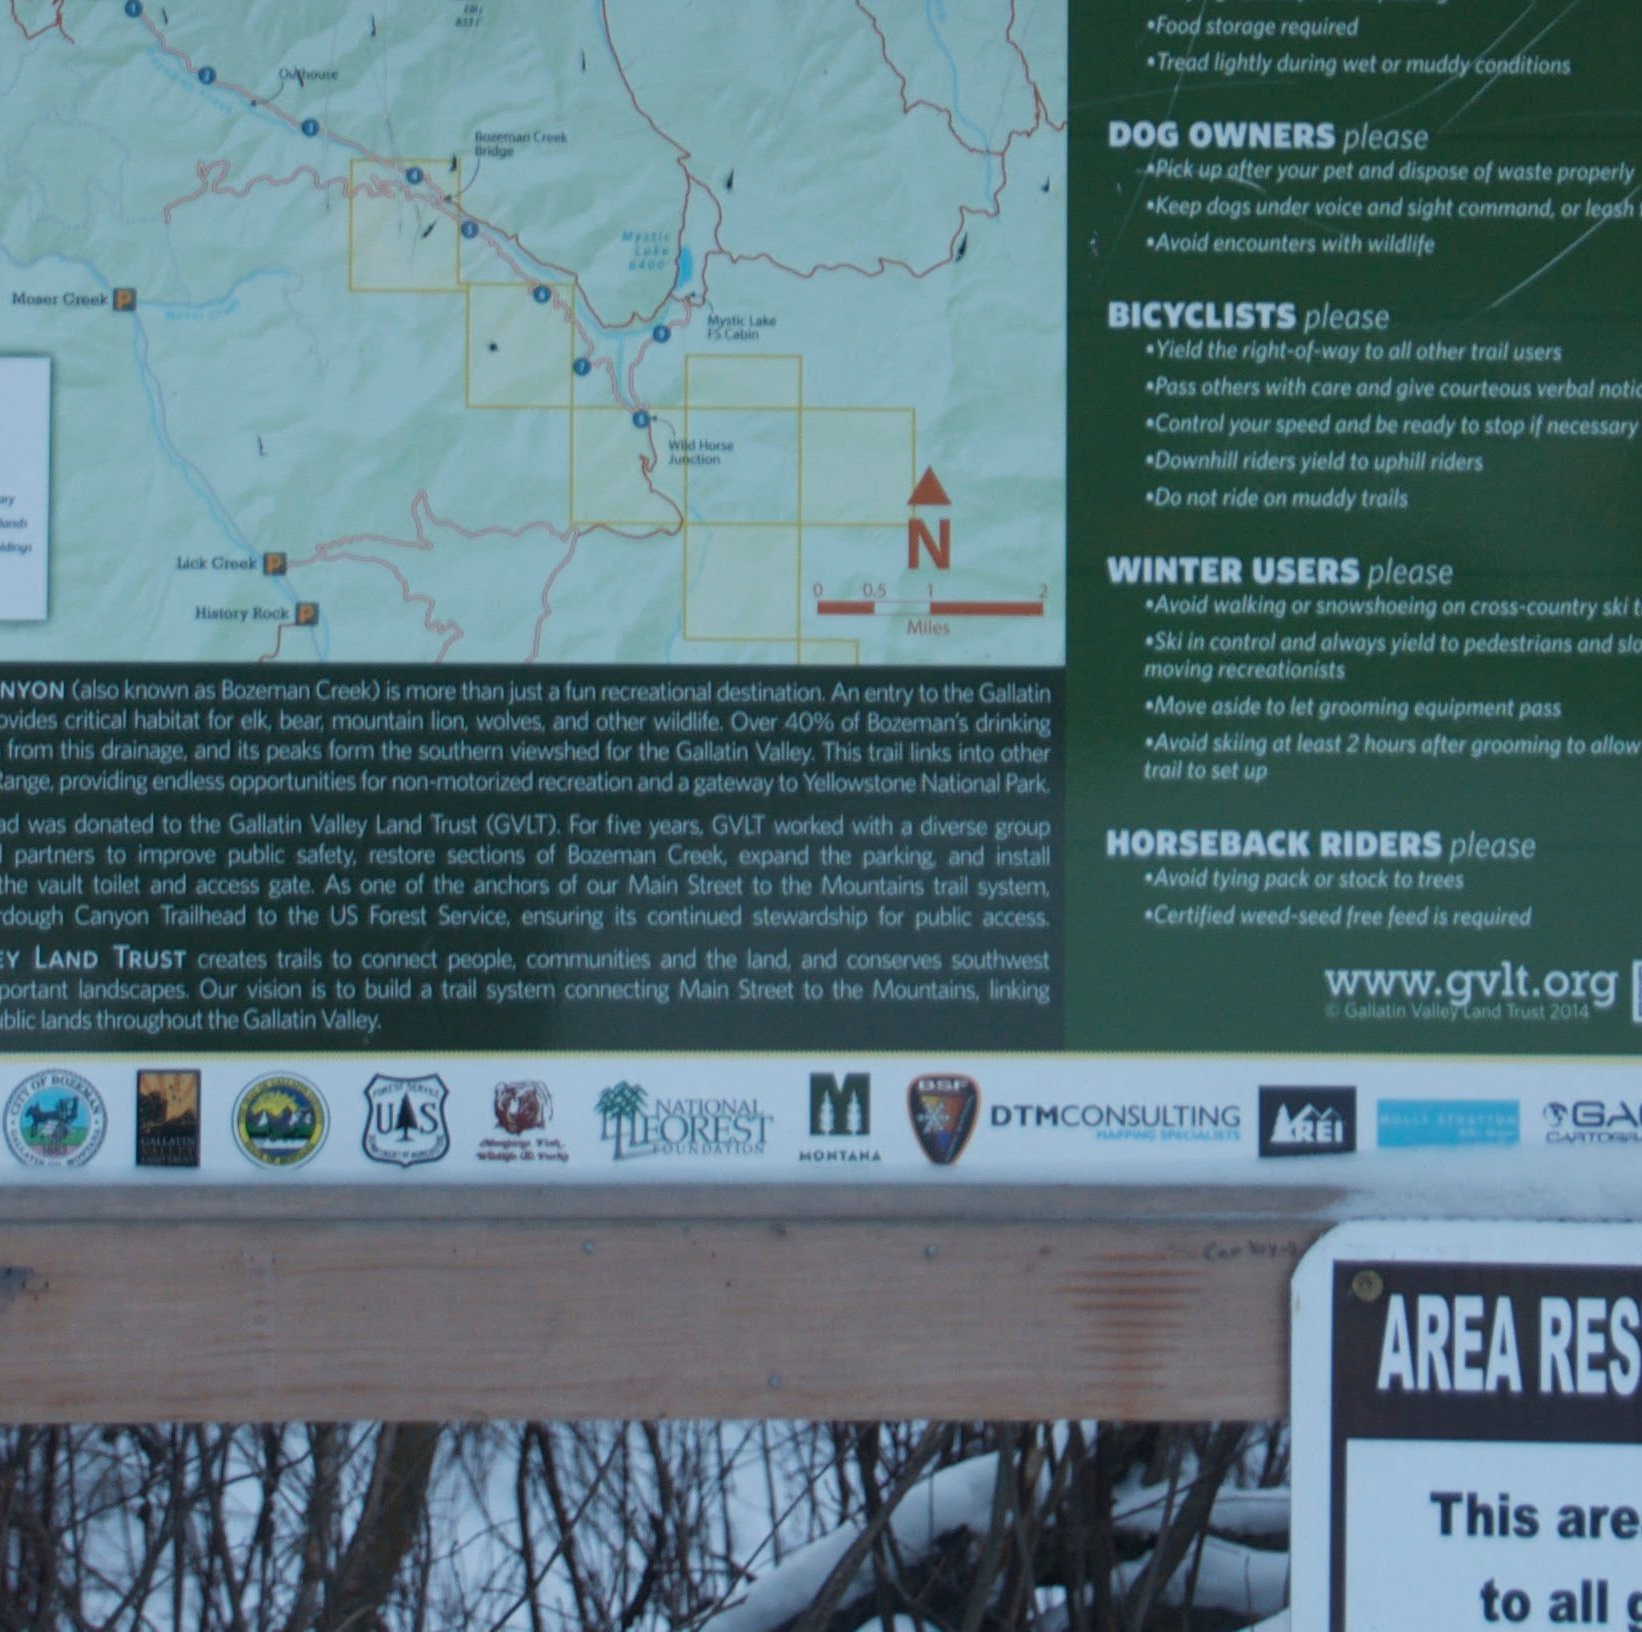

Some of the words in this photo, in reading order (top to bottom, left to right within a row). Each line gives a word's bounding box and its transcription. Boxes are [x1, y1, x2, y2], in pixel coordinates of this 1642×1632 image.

[475, 131, 528, 145] Bozeman
[531, 131, 568, 145] Creek
[1109, 121, 1179, 148] DOG
[1189, 121, 1336, 149] OWNERS
[1343, 123, 1428, 153] please
[475, 144, 514, 159] Bridge
[12, 292, 57, 305] Moser
[63, 293, 108, 306] Creek
[708, 315, 744, 329] Mystic
[749, 315, 777, 327] Lake
[1108, 301, 1296, 329] BICYCLISTS
[1304, 303, 1389, 334] please
[707, 326, 721, 340] FS
[725, 326, 759, 340] Cabin
[669, 439, 695, 455] Wild
[699, 441, 734, 451] Horse
[669, 452, 720, 468] Junction
[907, 519, 950, 570] N
[177, 557, 206, 570] Lick
[211, 556, 257, 570] Creek
[1107, 557, 1242, 583] WINTER
[1253, 557, 1360, 585] USERS
[1368, 558, 1453, 588] please
[195, 607, 248, 622] History
[253, 607, 291, 624] Rock
[907, 619, 950, 635] Miles
[72, 679, 119, 701] (also
[124, 679, 189, 700] known
[194, 684, 216, 700] as
[221, 679, 310, 700] Bozeman
[316, 679, 380, 701] Creek)
[386, 681, 400, 701] is
[405, 685, 456, 701] more
[461, 681, 504, 701] than
[509, 682, 542, 705] just
[549, 686, 560, 701] a
[565, 680, 596, 701] fun
[601, 681, 712, 702] recreational
[716, 682, 824, 703] destination.
[831, 682, 859, 702] An
[864, 684, 914, 705] entry
[919, 684, 939, 703] to
[943, 683, 974, 703] the
[979, 682, 1051, 703] Gallatin
[1107, 829, 1310, 858] HORSEBACK
[1320, 831, 1442, 859] RIDERS
[1450, 831, 1535, 862] please
[1325, 961, 1619, 1008] www.gvlt.org
[41, 1010, 92, 1030] lands
[96, 1009, 203, 1034] throughout
[208, 1009, 239, 1030] the
[243, 1009, 316, 1030] Gallatin
[321, 1010, 381, 1034] Valley.
[1344, 1003, 1405, 1019] Gallatin
[1413, 1003, 1459, 1023] Valley
[1464, 1003, 1502, 1020] Land
[1507, 1004, 1545, 1021] Trust
[1550, 1004, 1590, 1021] 2014
[655, 1099, 769, 1117] NATIONAL
[641, 1116, 773, 1146] FOREST
[1297, 1116, 1343, 1142] REI
[799, 1151, 881, 1162] MONTANA
[1378, 1295, 1522, 1392] AREA
[1431, 1493, 1539, 1538] This
[1481, 1581, 1530, 1622] to
[1549, 1581, 1607, 1623] all
